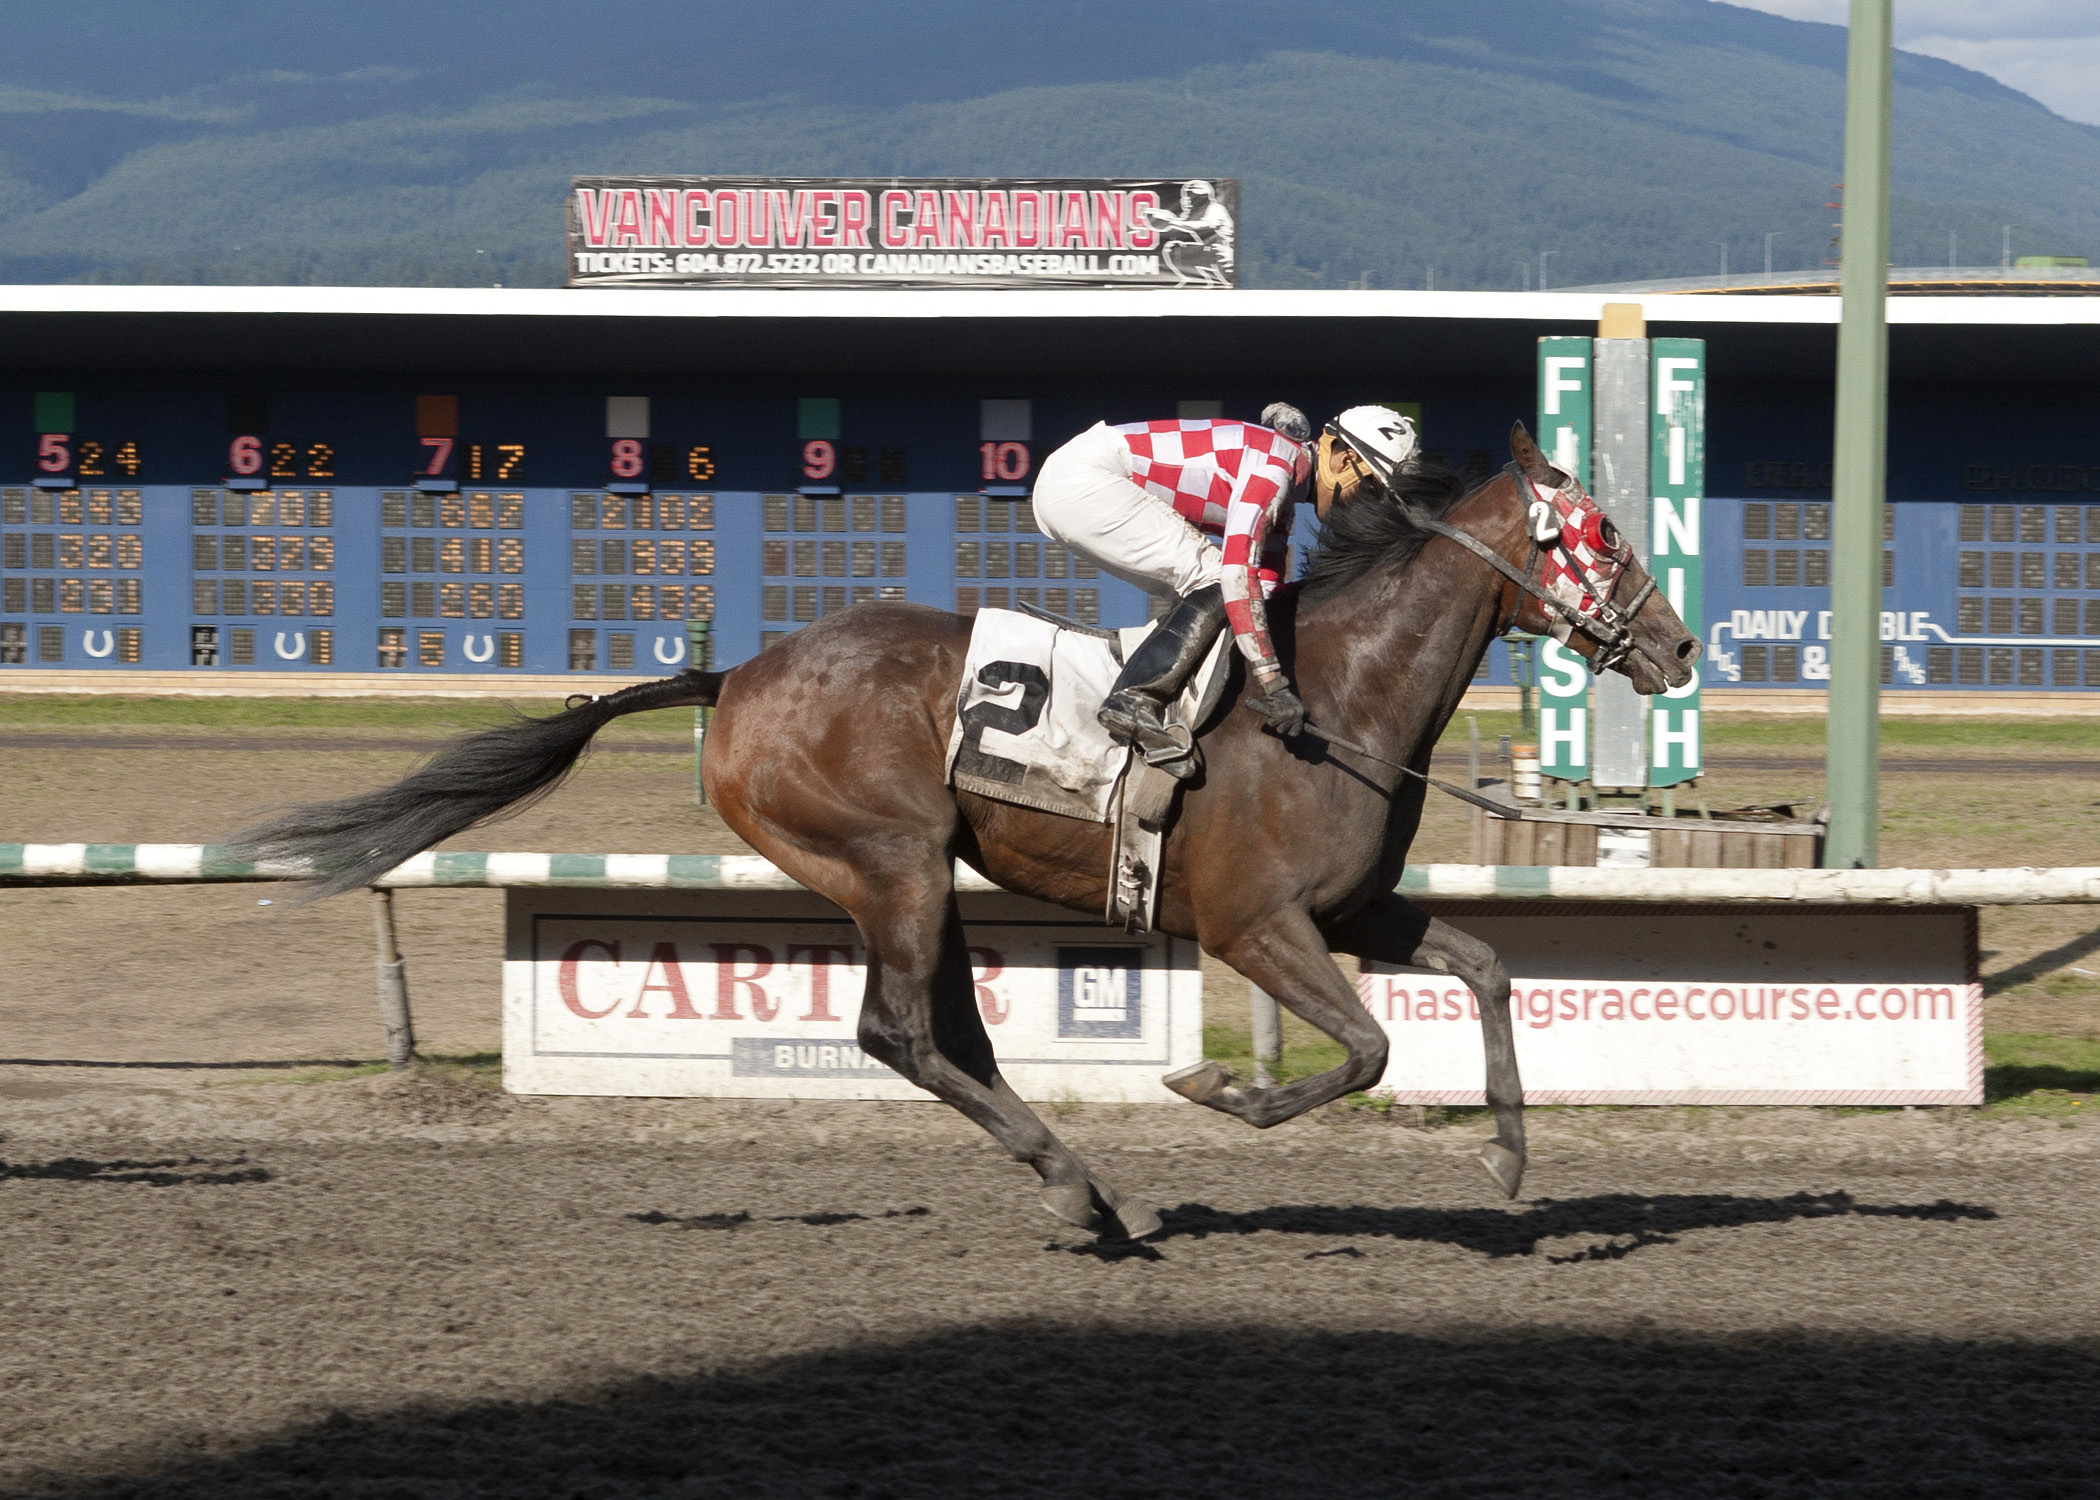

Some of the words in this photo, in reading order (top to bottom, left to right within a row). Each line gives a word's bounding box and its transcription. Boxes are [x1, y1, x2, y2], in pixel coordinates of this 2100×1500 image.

[576, 188, 872, 248] VANCOUVER
[879, 189, 1160, 250] CANADIANS
[574, 252, 674, 273] TICKETS:
[822, 254, 858, 274] OR
[859, 254, 1160, 275] CANADIANSBASEBALL.COM
[38, 434, 70, 472] 5
[79, 442, 142, 475] 24
[229, 436, 262, 474] 6
[271, 443, 334, 476] 22
[419, 438, 454, 475] 7
[471, 445, 524, 479] 17
[611, 440, 643, 477] 8
[689, 447, 714, 480] 6
[803, 440, 836, 479] 9
[979, 442, 1030, 480] 10
[1528, 501, 1558, 543] 2
[1731, 610, 1809, 640] DAILY
[1818, 610, 1930, 641] DBLE
[954, 660, 1050, 786] 2
[559, 938, 1010, 1025] CARTR
[1073, 964, 1128, 1009] GM
